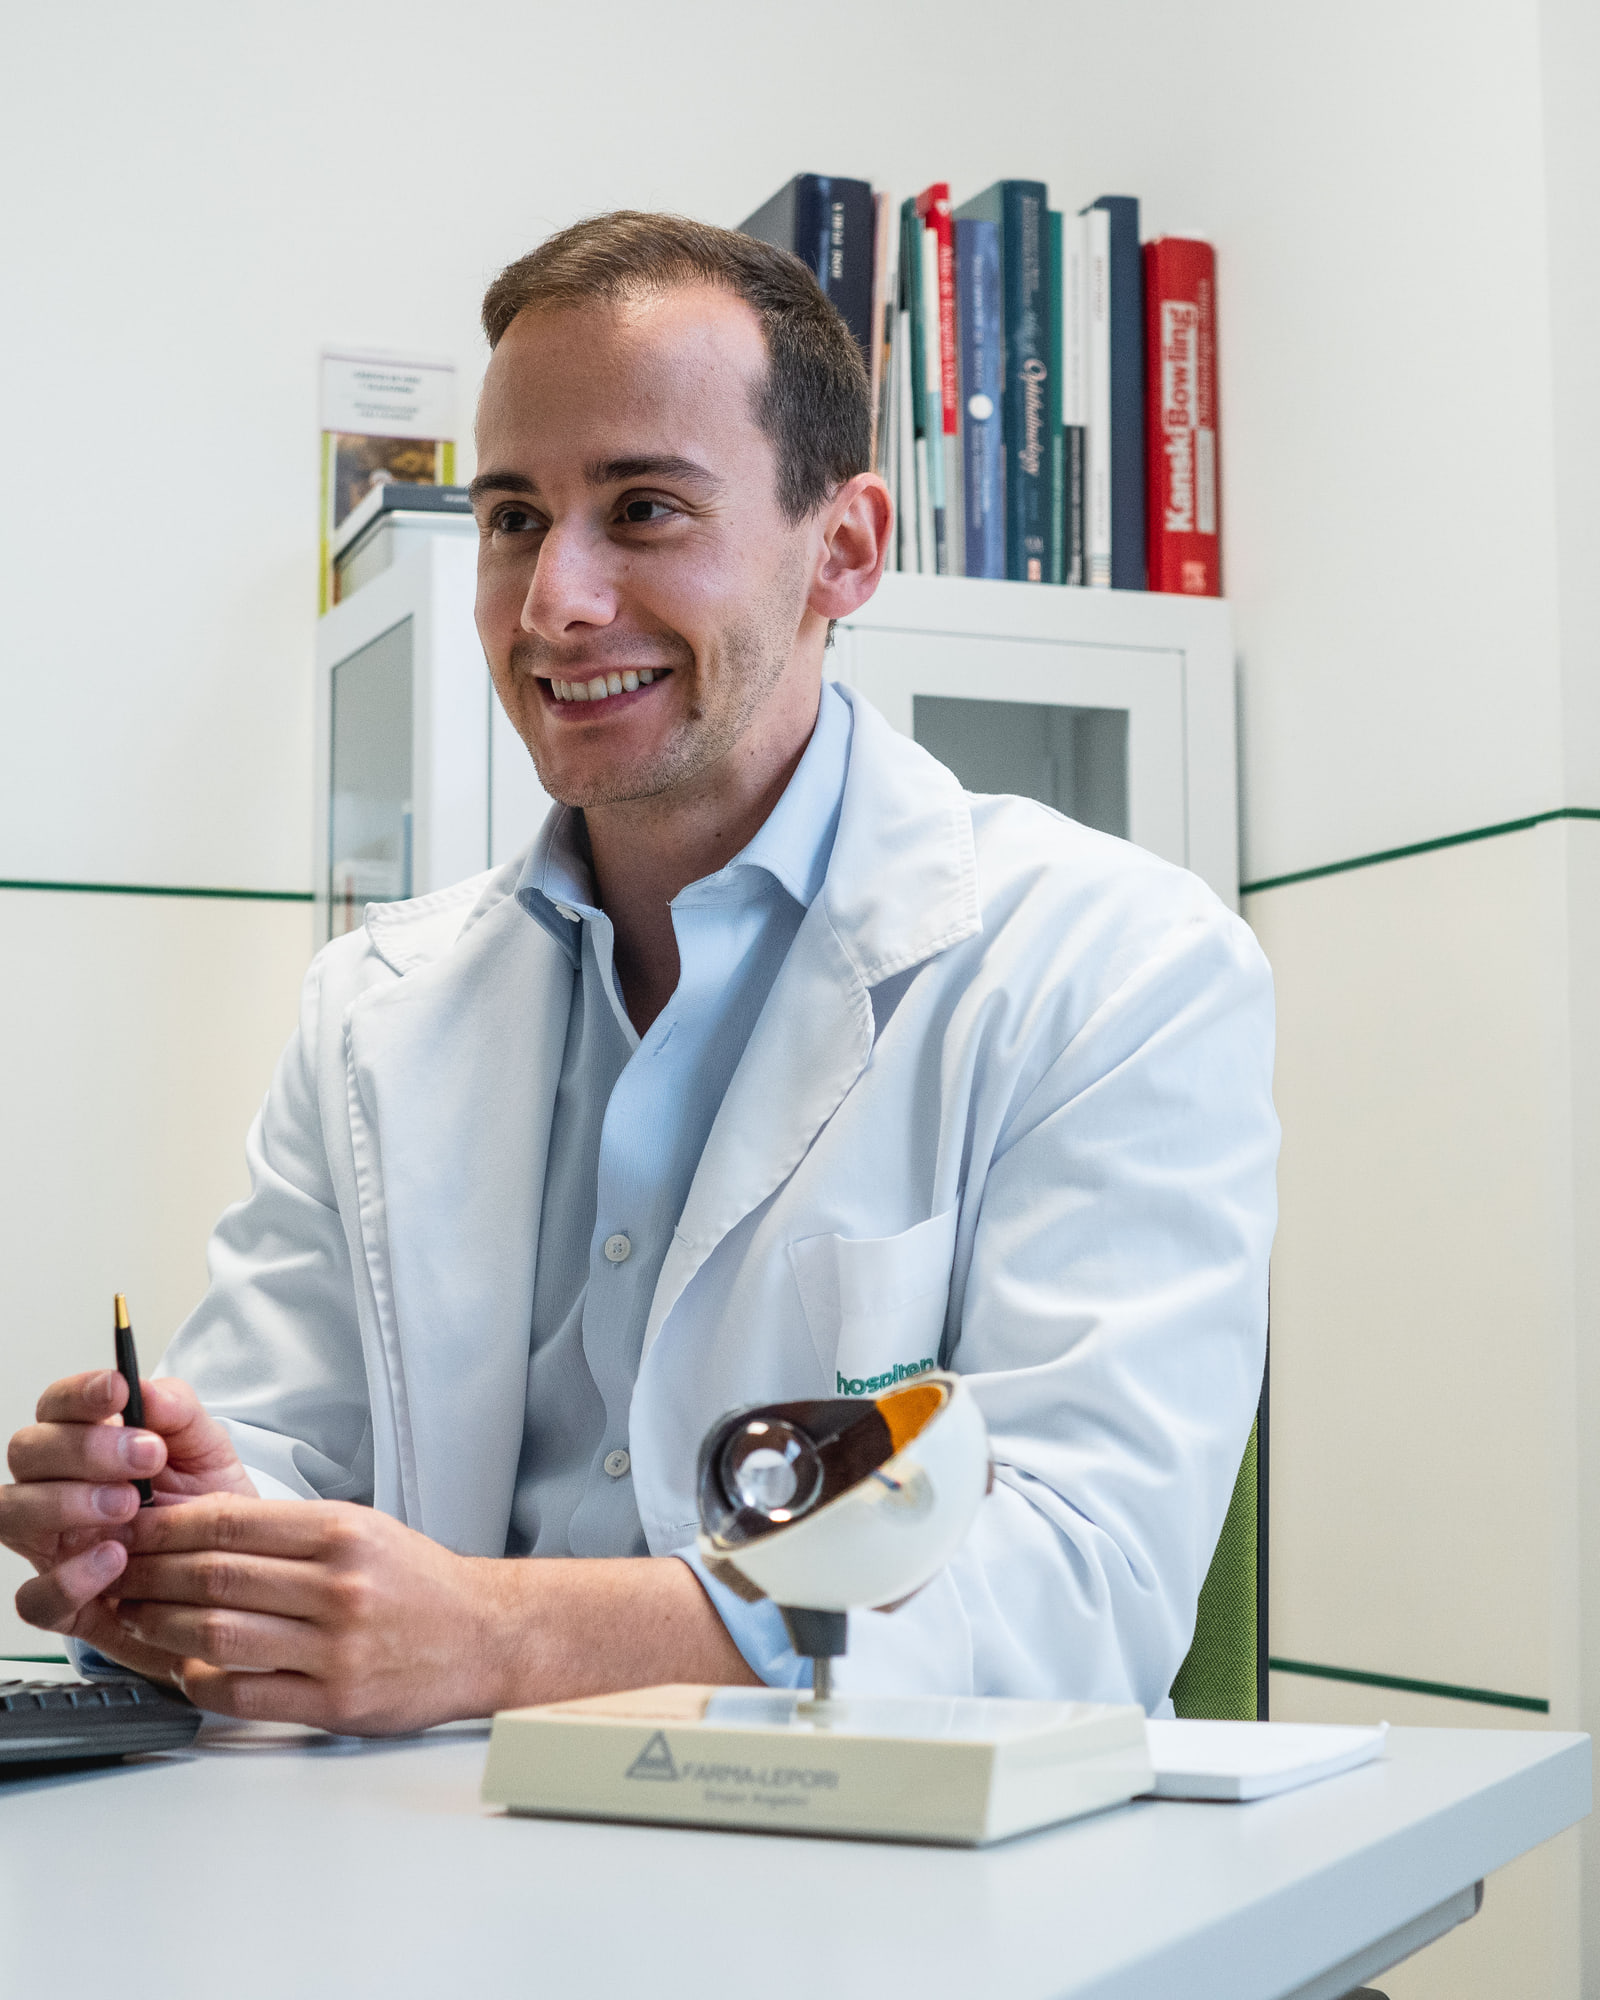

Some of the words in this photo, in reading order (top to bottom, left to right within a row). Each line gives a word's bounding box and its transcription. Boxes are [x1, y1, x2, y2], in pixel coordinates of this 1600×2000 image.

[1166, 307, 1196, 427] Bowling
[1164, 428, 1195, 532] Kanski
[836, 1357, 935, 1396] hospiten
